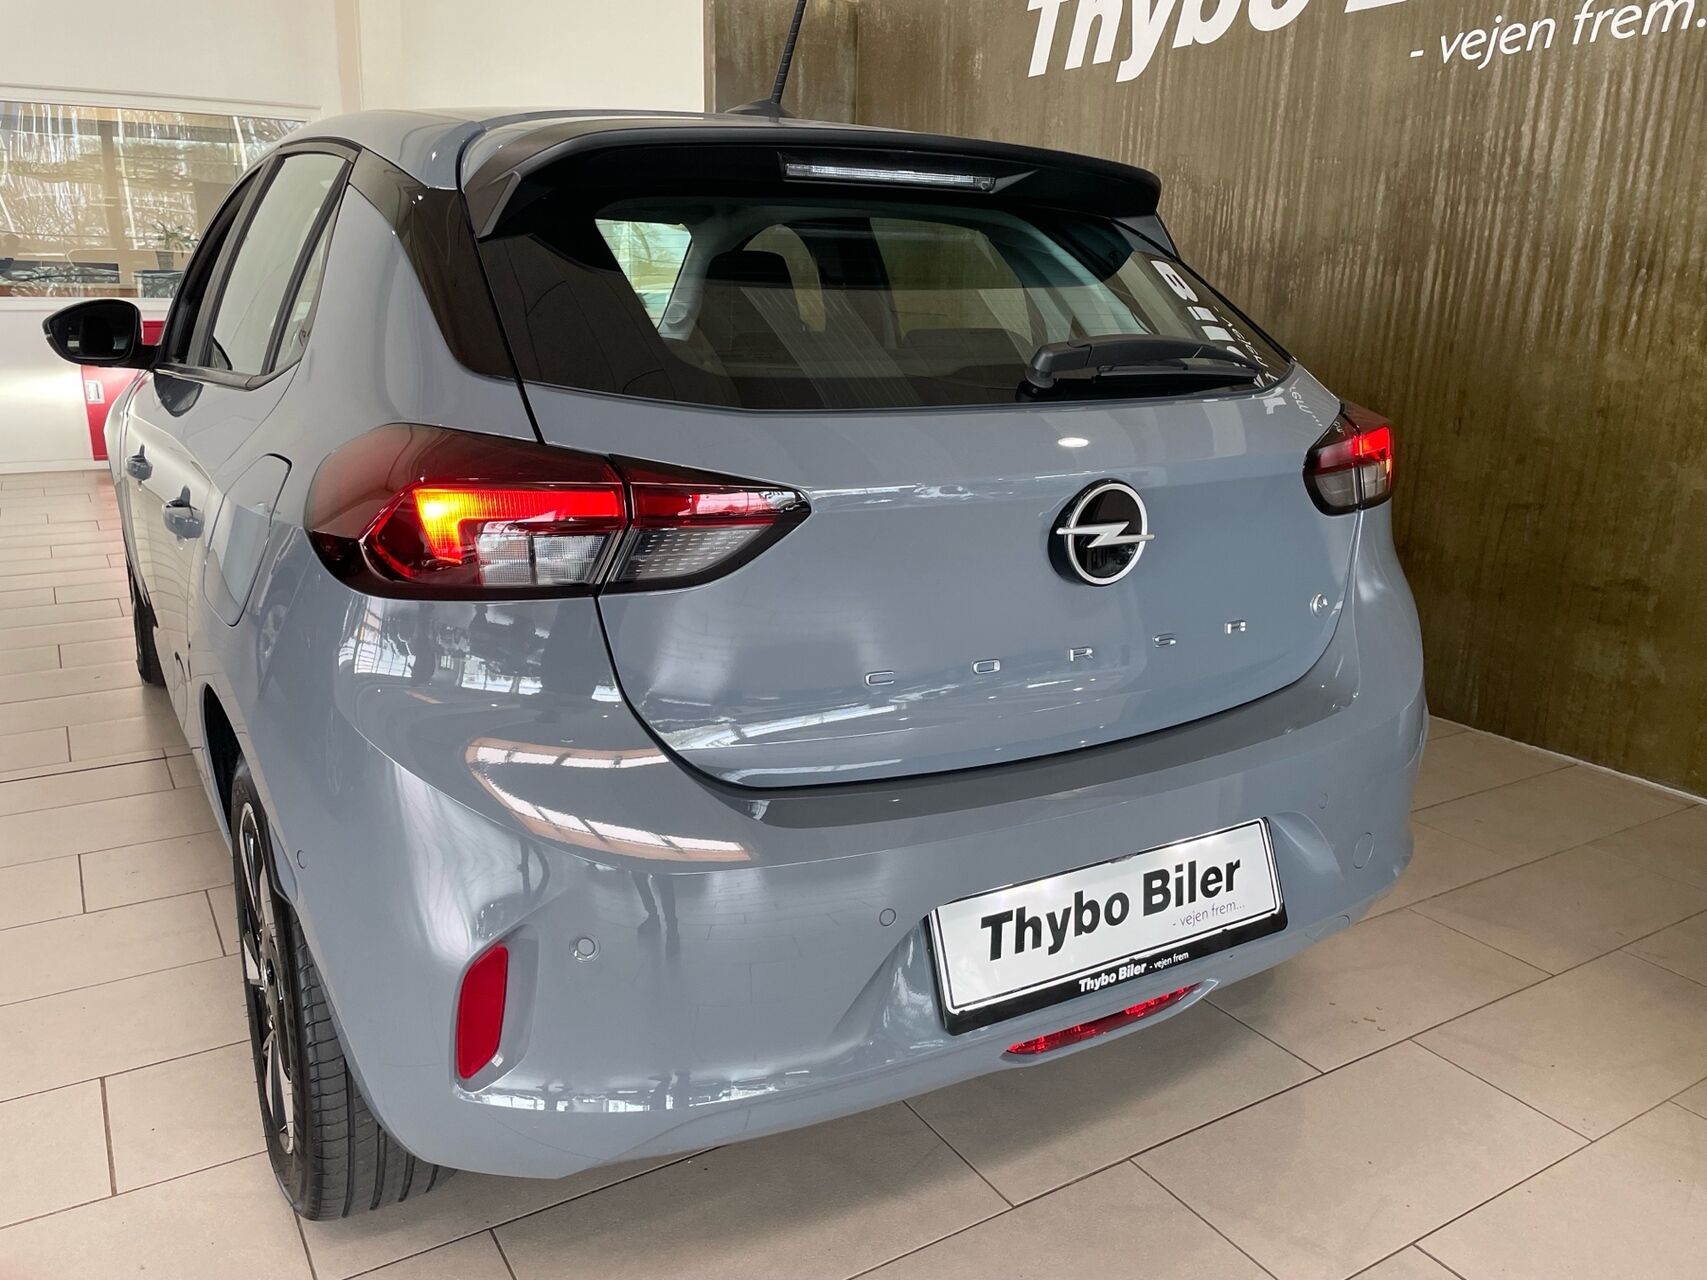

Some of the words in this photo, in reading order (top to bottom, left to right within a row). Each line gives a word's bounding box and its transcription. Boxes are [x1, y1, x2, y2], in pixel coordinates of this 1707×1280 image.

[1440, 14, 1556, 70] vejen
[980, 890, 1130, 962] Thybo
[1142, 858, 1240, 917] Biler
[1180, 910, 1209, 927] vejen
[1078, 973, 1116, 992] Thybo
[1118, 963, 1147, 981] Biler
[1153, 957, 1172, 969] vejen
[1172, 952, 1189, 963] frem
